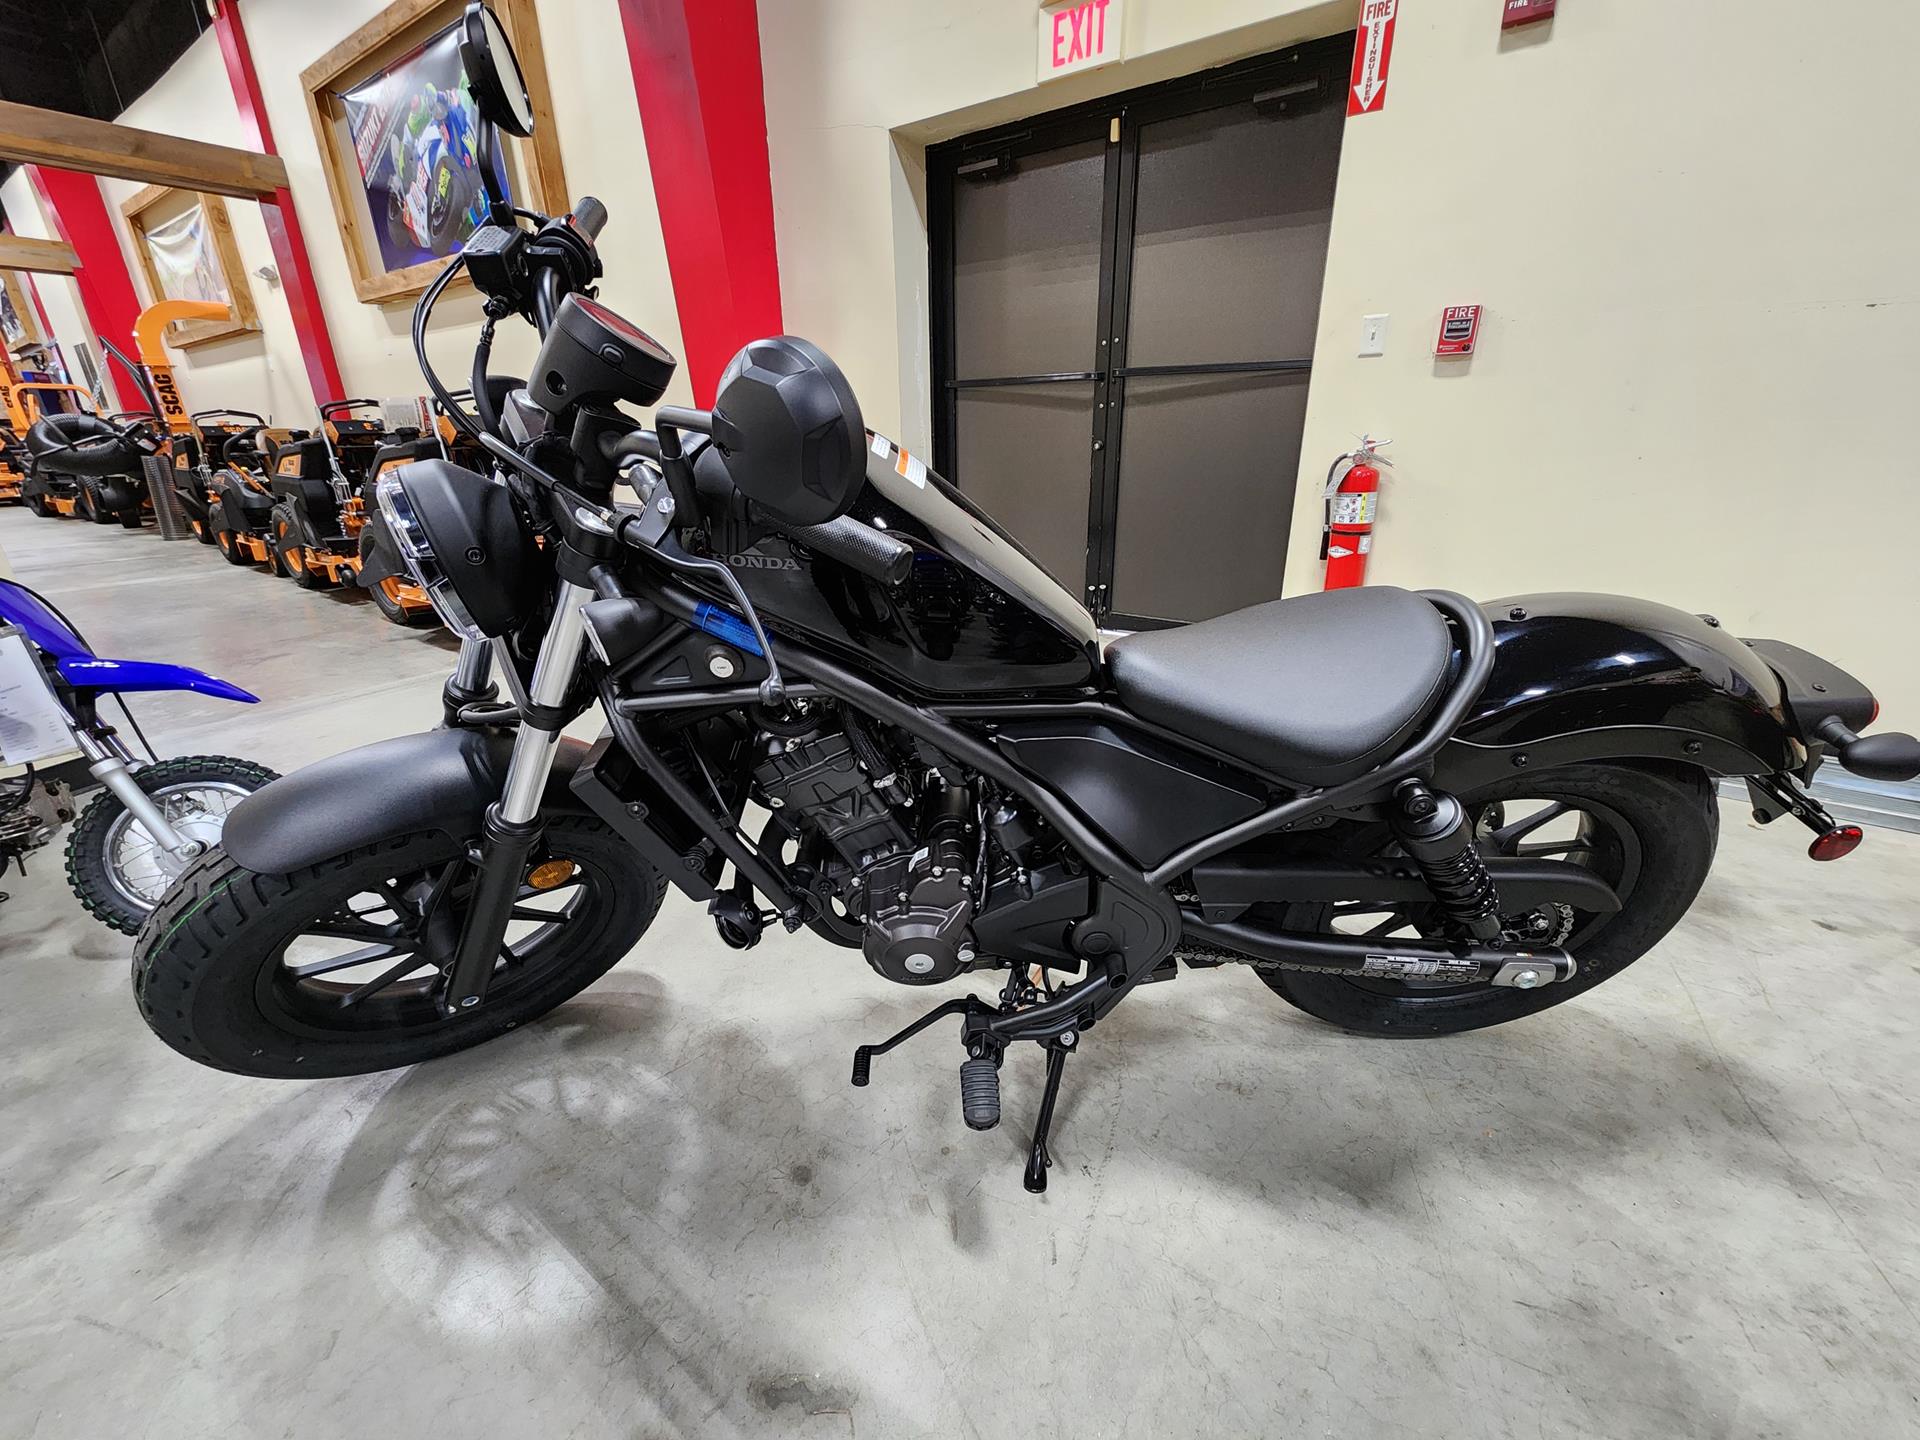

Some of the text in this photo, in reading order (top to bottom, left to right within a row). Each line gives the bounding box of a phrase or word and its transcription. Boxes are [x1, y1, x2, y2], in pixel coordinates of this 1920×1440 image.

[1366, 0, 1392, 20] FIRE
[1053, 0, 1109, 67] EXIT
[1363, 21, 1380, 102] EXTINGUISHER
[1446, 307, 1476, 318] FIRE
